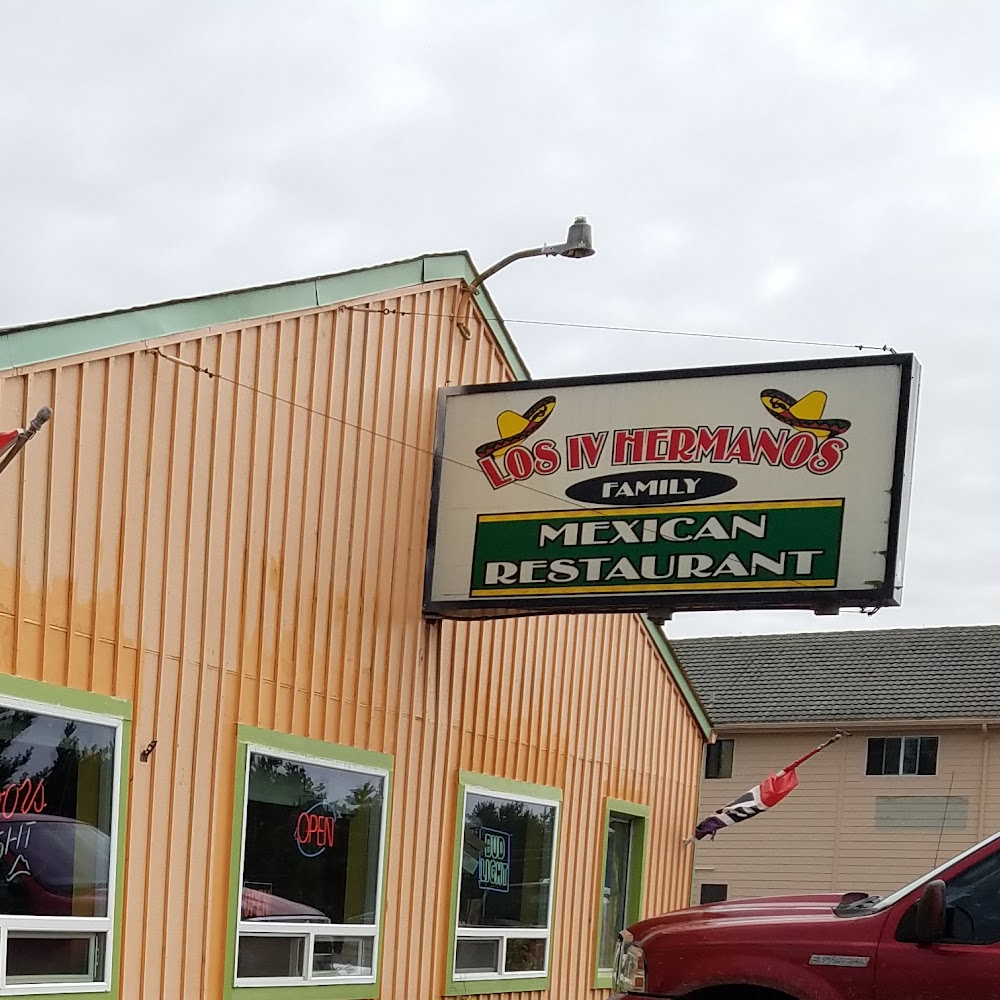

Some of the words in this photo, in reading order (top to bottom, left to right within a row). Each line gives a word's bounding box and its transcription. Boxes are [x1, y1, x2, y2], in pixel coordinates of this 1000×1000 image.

[478, 437, 562, 490] LOS
[566, 430, 608, 471] IV
[611, 424, 850, 475] HERMANOS
[601, 477, 701, 499] FAMILY
[538, 514, 767, 547] MEXICAN
[484, 549, 823, 587] RESTAURANT
[297, 812, 335, 847] OPEN
[484, 833, 506, 860] BUD
[480, 858, 509, 886] LIGHT
